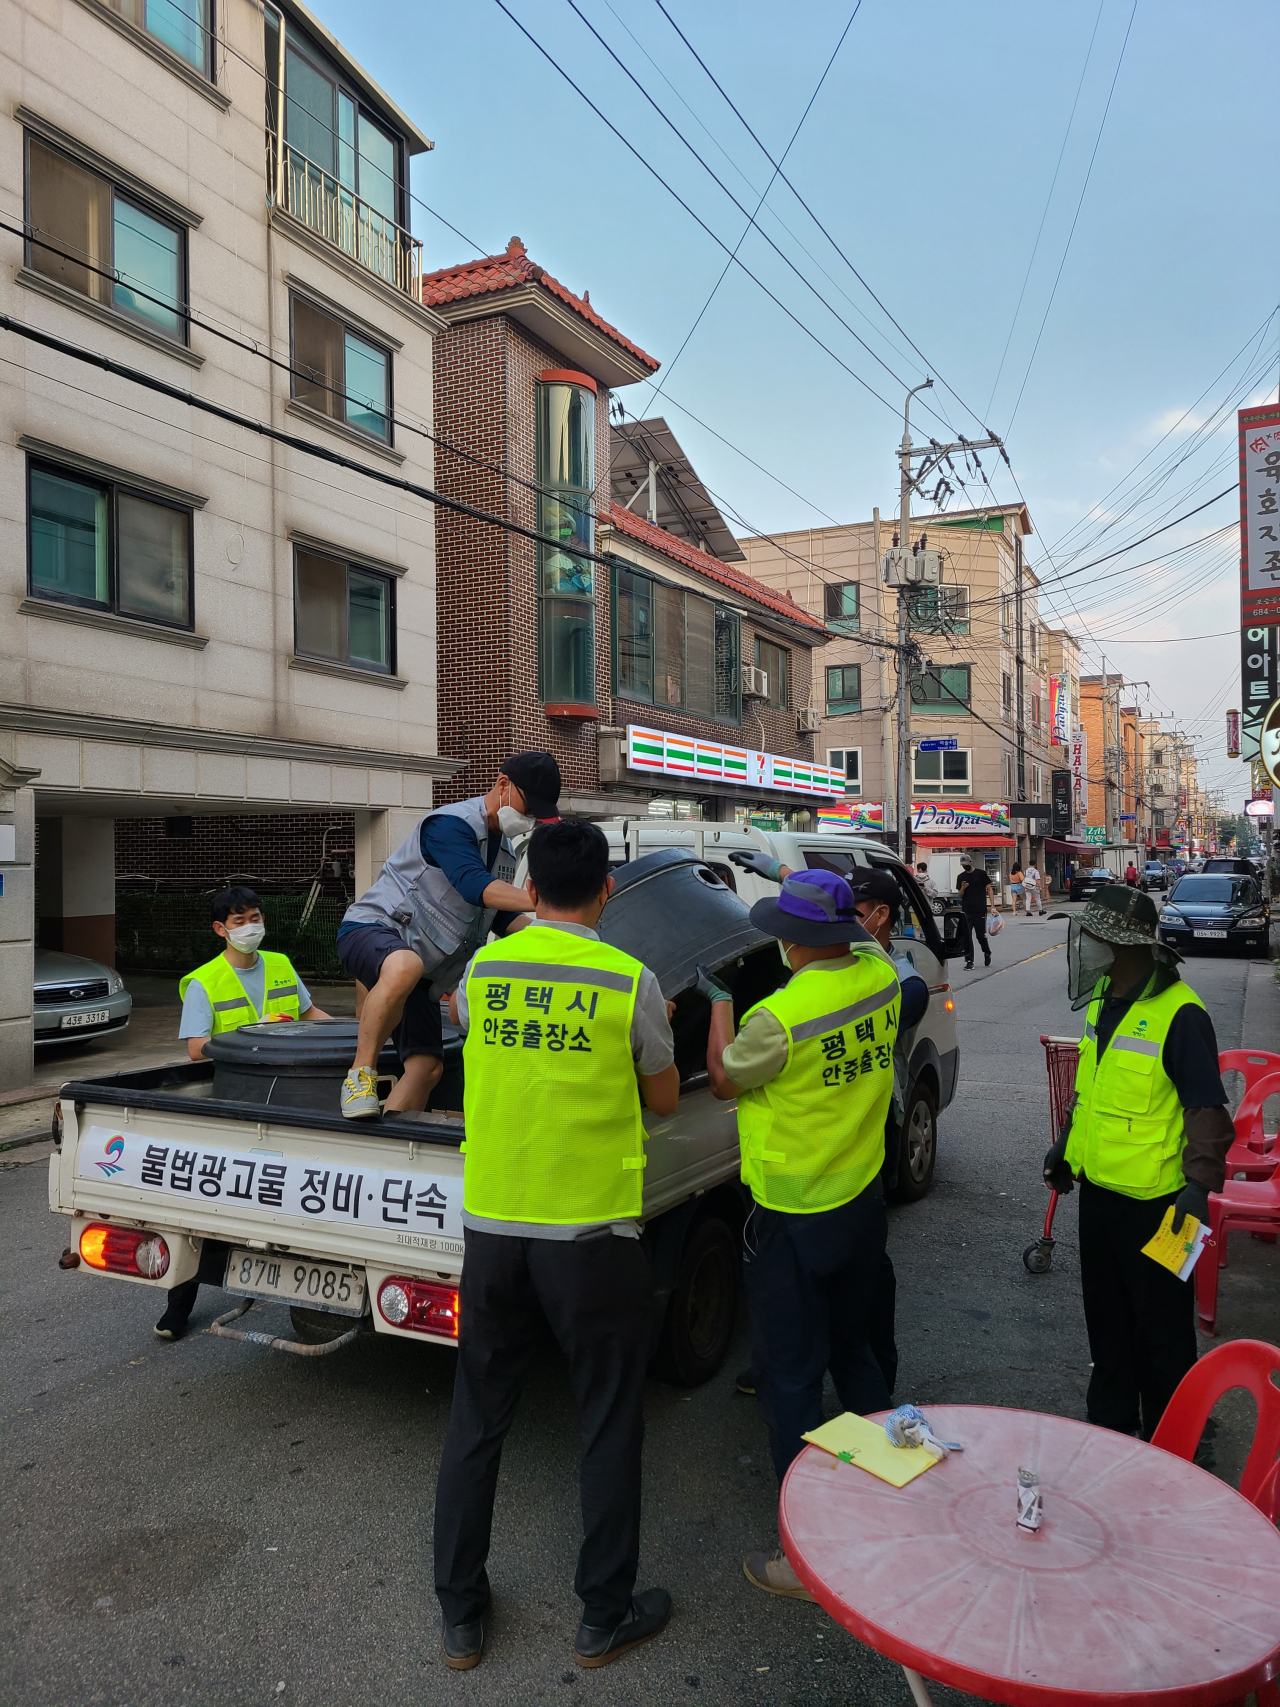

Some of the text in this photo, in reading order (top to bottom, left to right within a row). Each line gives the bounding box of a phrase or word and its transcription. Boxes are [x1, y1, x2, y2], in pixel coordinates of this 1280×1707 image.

[86, 1012, 105, 1024] 3318
[485, 983, 598, 1019] 평택시
[482, 1017, 593, 1052] 안중출장소
[821, 1004, 897, 1061] 평택시
[822, 1041, 893, 1087] 안중출장
[141, 1143, 287, 1207] 불법광고물
[396, 1234, 437, 1250] 최대적재량
[238, 1257, 353, 1302] 87마 9085
